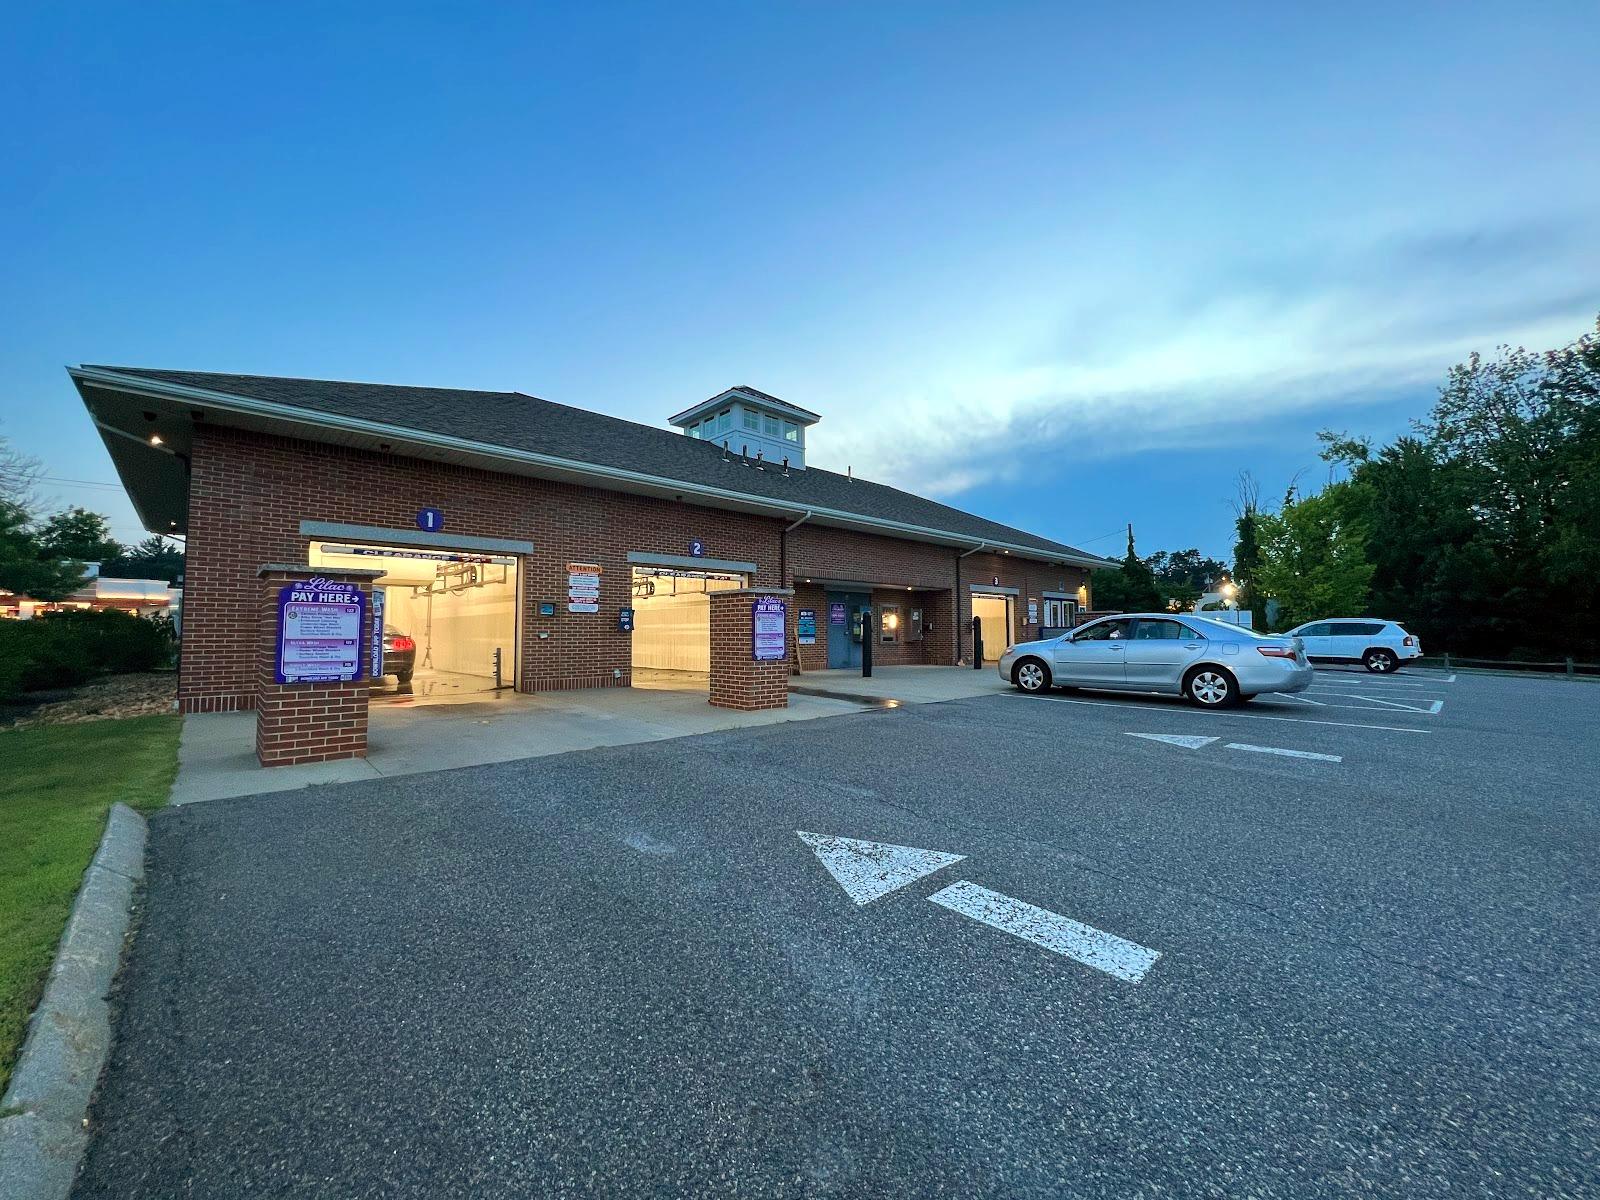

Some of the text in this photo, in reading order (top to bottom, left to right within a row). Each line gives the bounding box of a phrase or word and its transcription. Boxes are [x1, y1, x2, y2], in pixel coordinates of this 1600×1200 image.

[426, 512, 434, 528] 1
[693, 542, 701, 555] 2
[363, 550, 451, 561] CLEARANCE
[568, 565, 601, 573] ATTENTION
[304, 577, 345, 592] Lilac
[291, 592, 351, 603] PAY HERE
